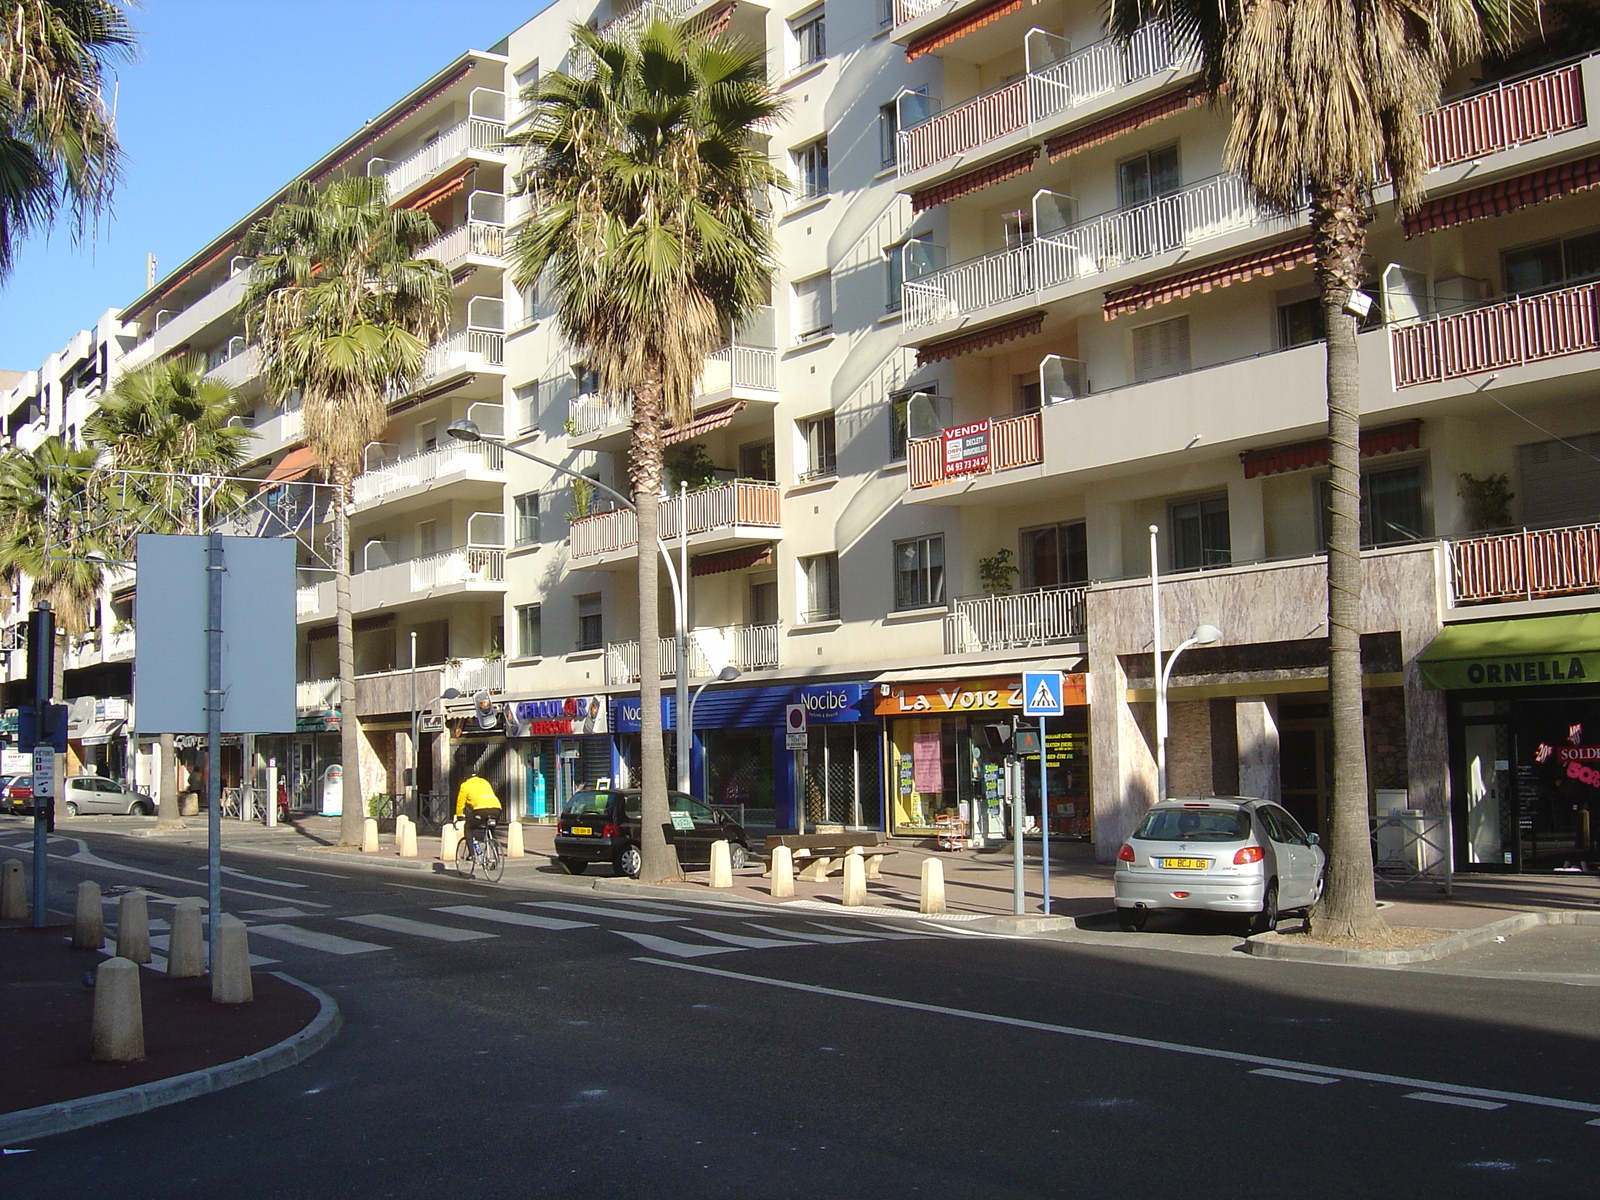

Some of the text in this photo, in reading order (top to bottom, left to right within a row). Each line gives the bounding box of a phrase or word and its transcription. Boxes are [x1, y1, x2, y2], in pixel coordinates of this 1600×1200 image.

[946, 422, 988, 439] VENDU
[946, 456, 988, 473] 04 93 73 24 24
[1467, 657, 1586, 684] ORNELLA
[800, 690, 848, 710] Nocibé
[900, 689, 931, 712] La
[936, 686, 999, 710] Voie
[1164, 858, 1206, 868] 14 BCJ 06
